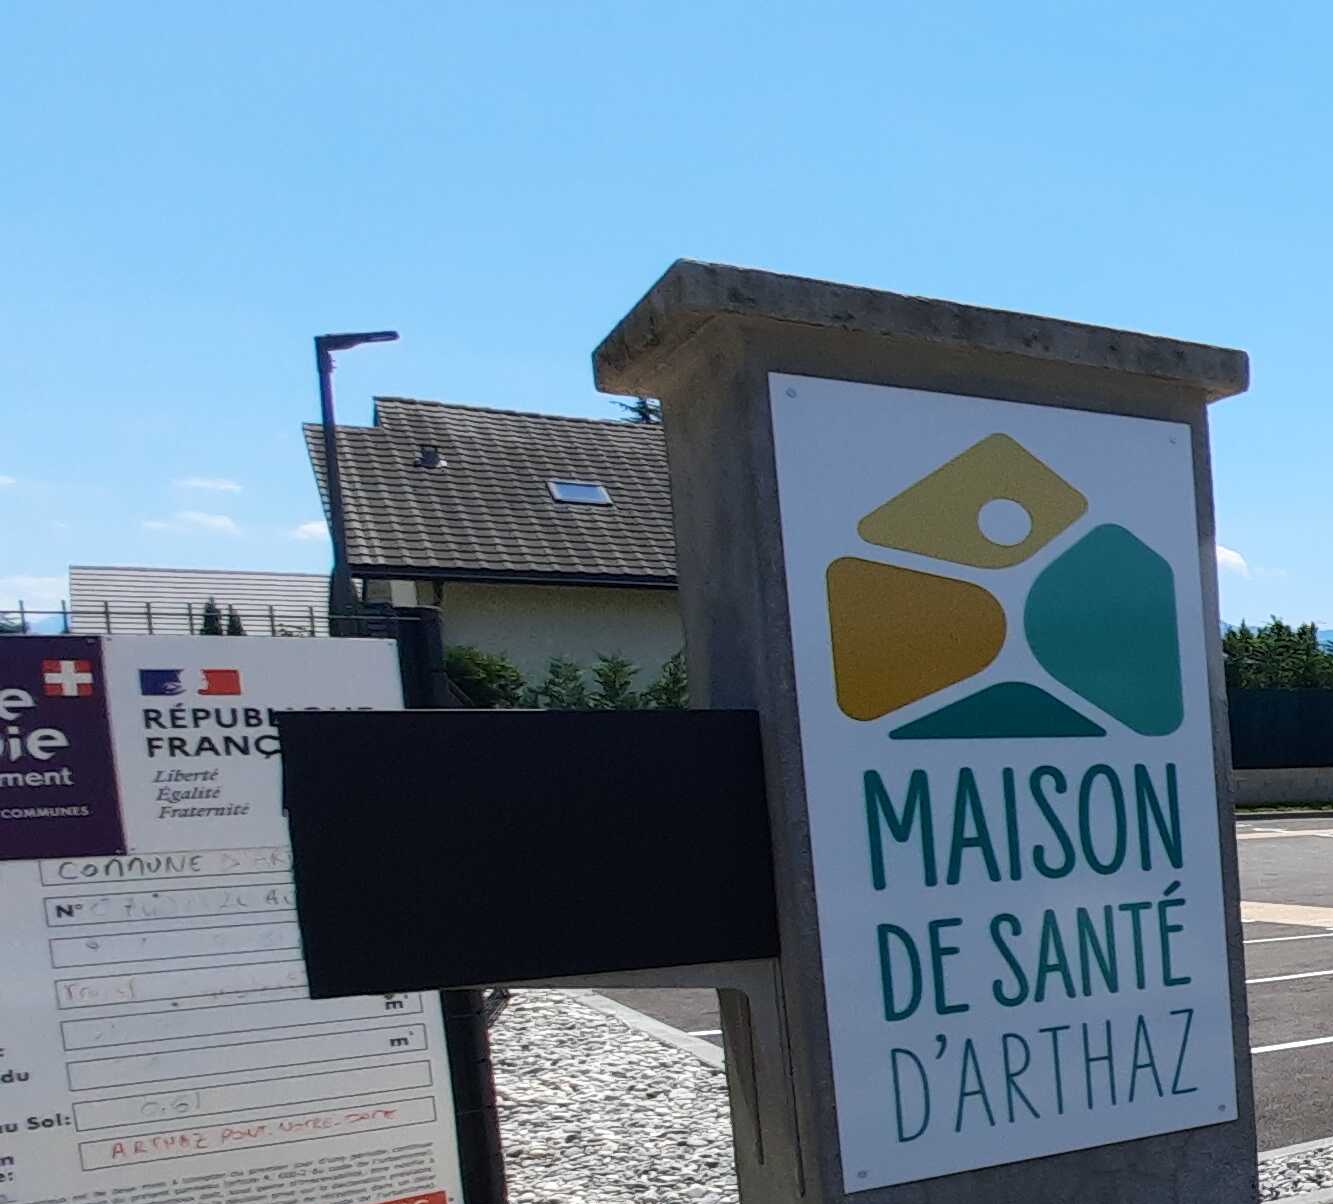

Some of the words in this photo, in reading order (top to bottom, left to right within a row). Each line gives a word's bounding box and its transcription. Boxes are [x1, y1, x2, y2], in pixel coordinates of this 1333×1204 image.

[146, 735, 282, 759] FRANÇ
[153, 768, 219, 783] Liberté
[156, 786, 221, 803] Égalité
[158, 804, 250, 819] Fraternité
[862, 762, 1184, 891] MAISON
[876, 917, 970, 1023] DE
[989, 880, 1192, 1008] SANTÉ
[890, 1008, 1198, 1144] D'ARTHAZ
[27, 1113, 72, 1131] Sol:
